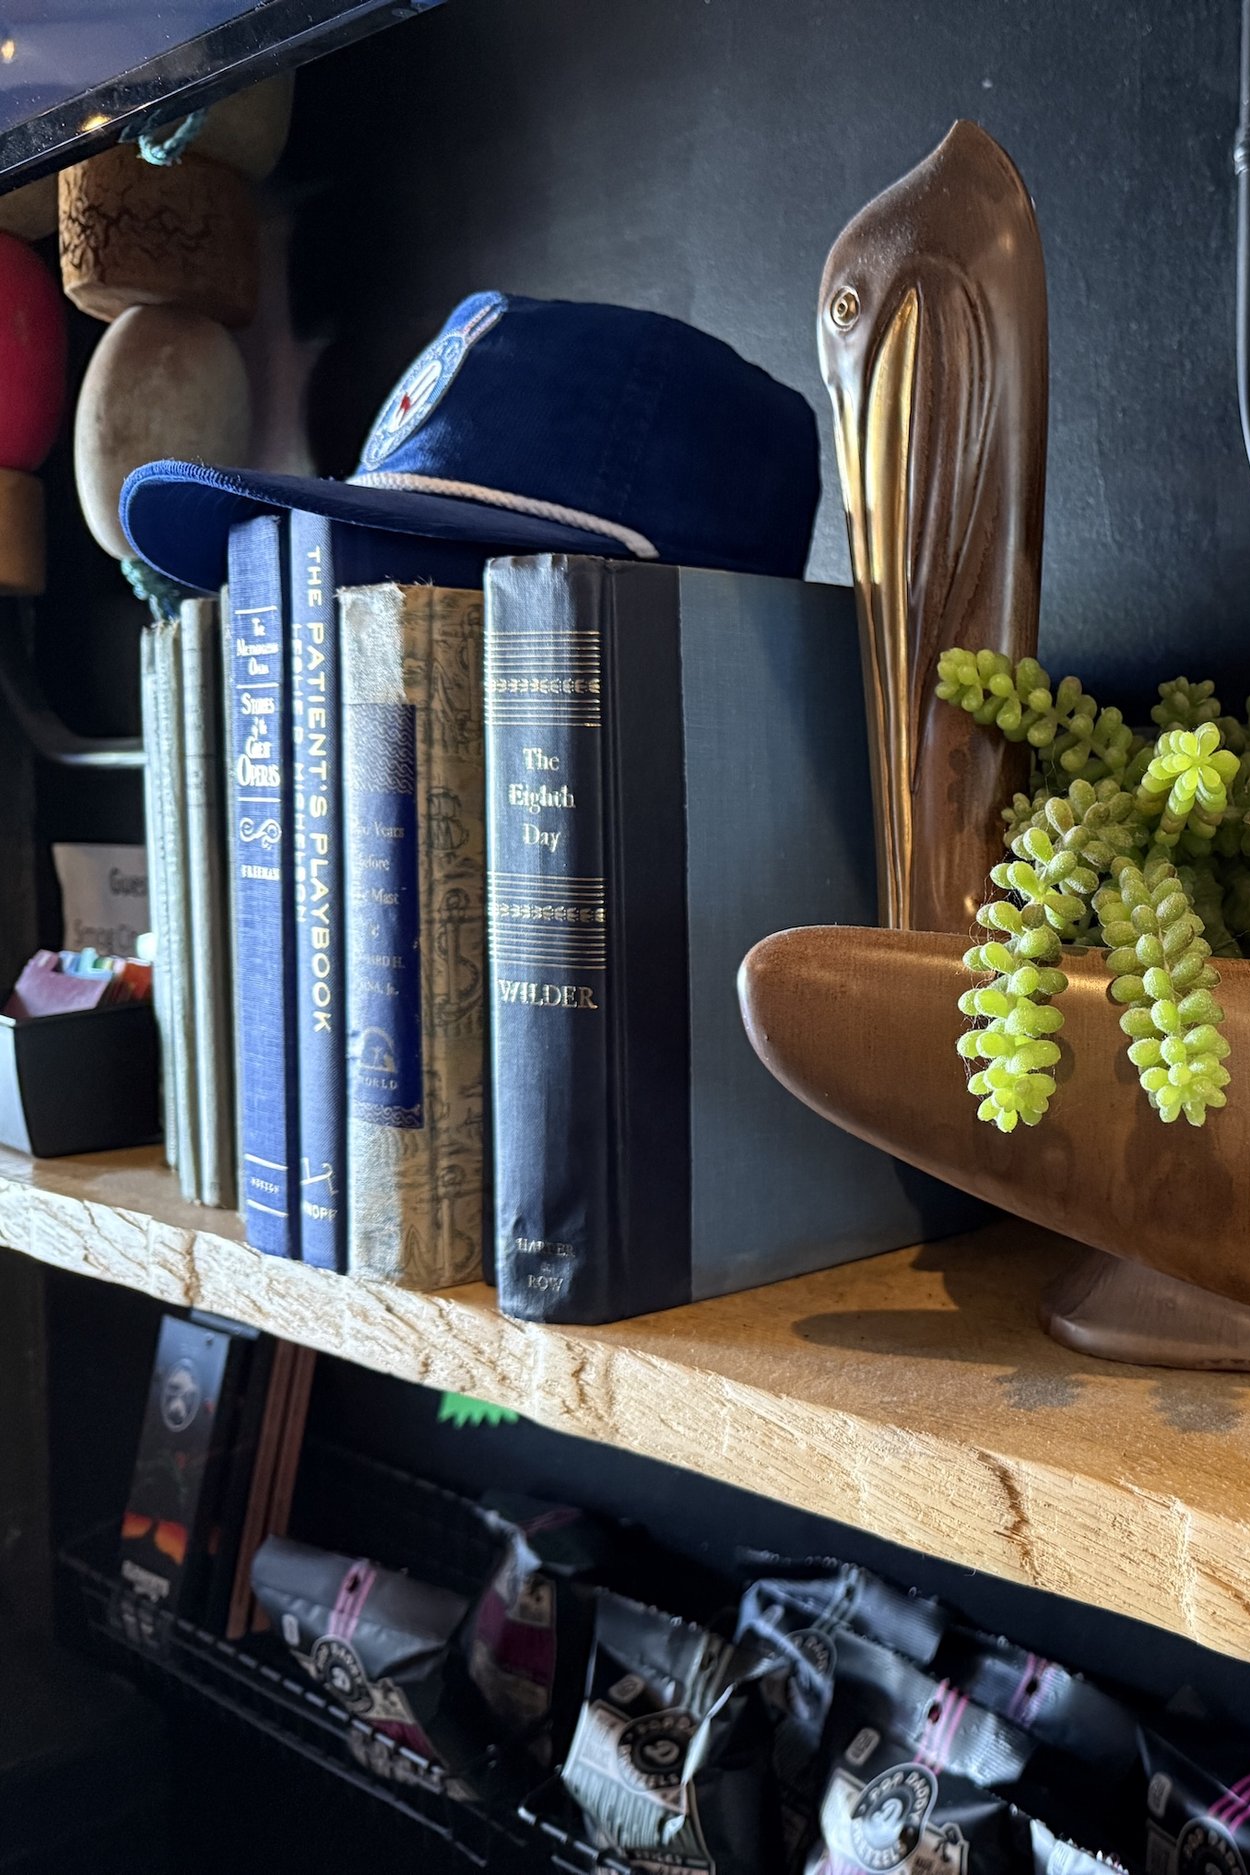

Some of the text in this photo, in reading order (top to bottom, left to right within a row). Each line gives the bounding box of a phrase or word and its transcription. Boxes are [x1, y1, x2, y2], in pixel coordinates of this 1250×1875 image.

[522, 747, 560, 771] The
[306, 545, 332, 1033] THE PATIENT'S PLAYBOOK
[508, 783, 576, 814] Eighth
[522, 823, 561, 853] Day
[353, 853, 391, 871] efore
[497, 978, 599, 1009] WILDER
[357, 1074, 398, 1090] ORLD
[528, 1274, 564, 1292] ROW
